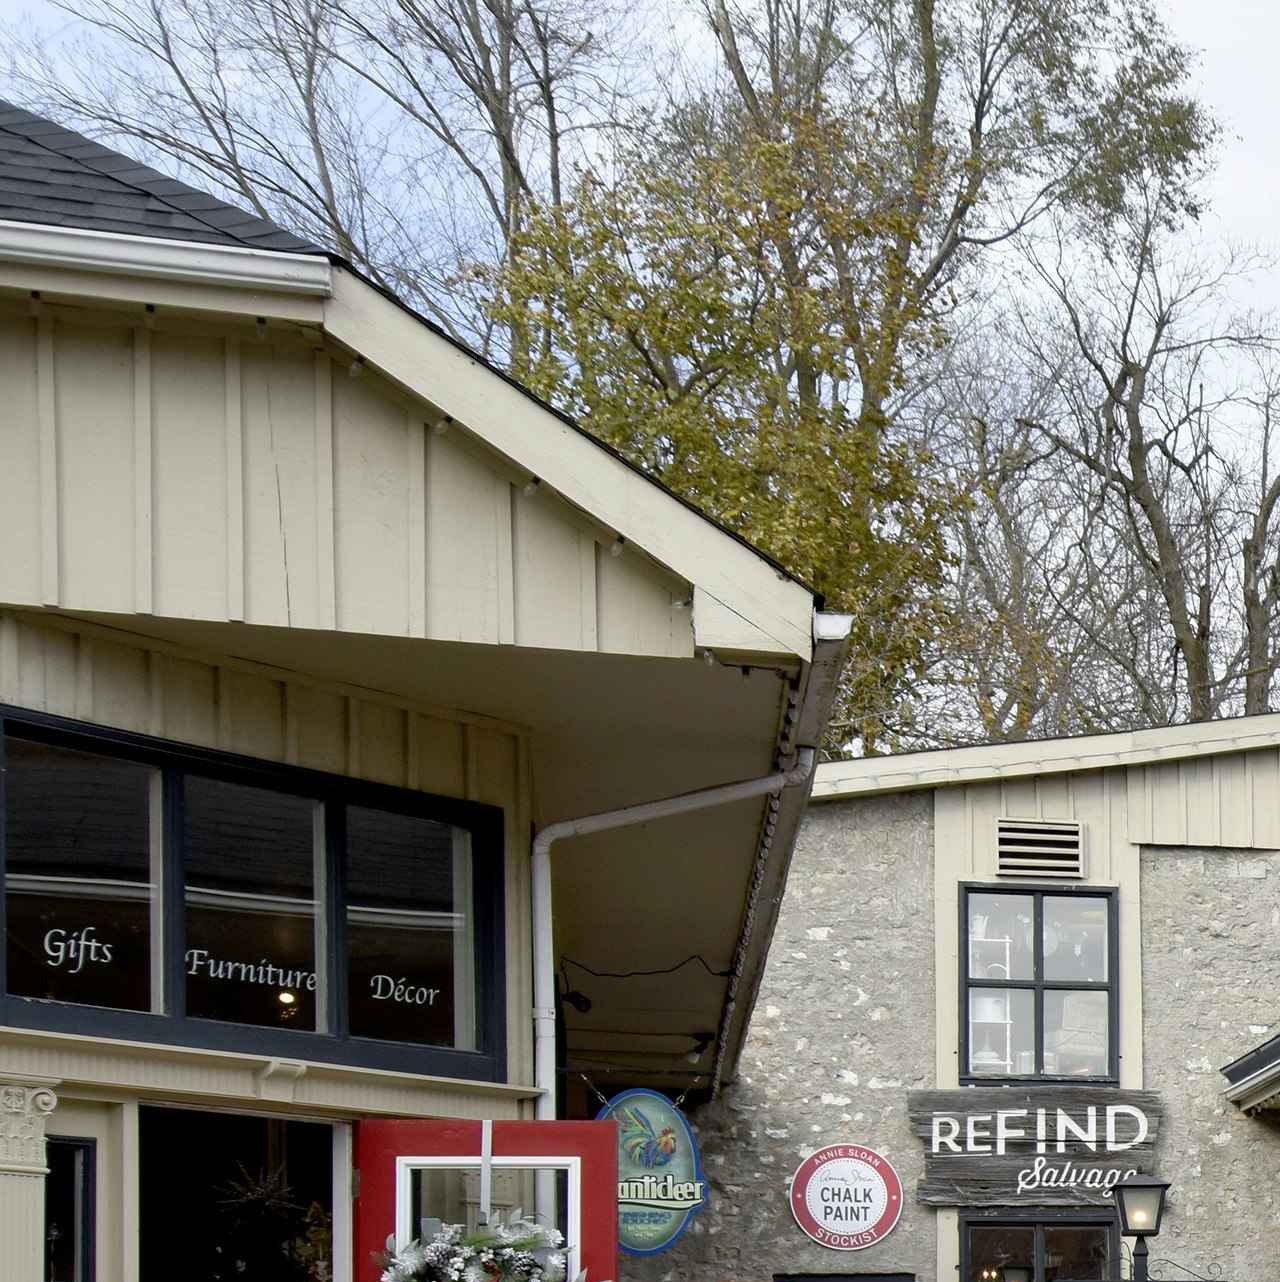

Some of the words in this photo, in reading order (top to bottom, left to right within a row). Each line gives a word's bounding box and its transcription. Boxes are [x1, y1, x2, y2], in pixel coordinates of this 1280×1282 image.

[43, 926, 113, 974] Gifts
[185, 949, 317, 992] Furniture
[371, 974, 440, 1006] Décor
[931, 1105, 1149, 1155] REFIND
[814, 1149, 844, 1166] ANNIE
[848, 1149, 881, 1167] SLOAN
[618, 1174, 705, 1202] anticleer
[821, 1187, 873, 1203] CHALK
[824, 1206, 870, 1221] PAINT
[815, 1228, 878, 1246] STOCKIST
